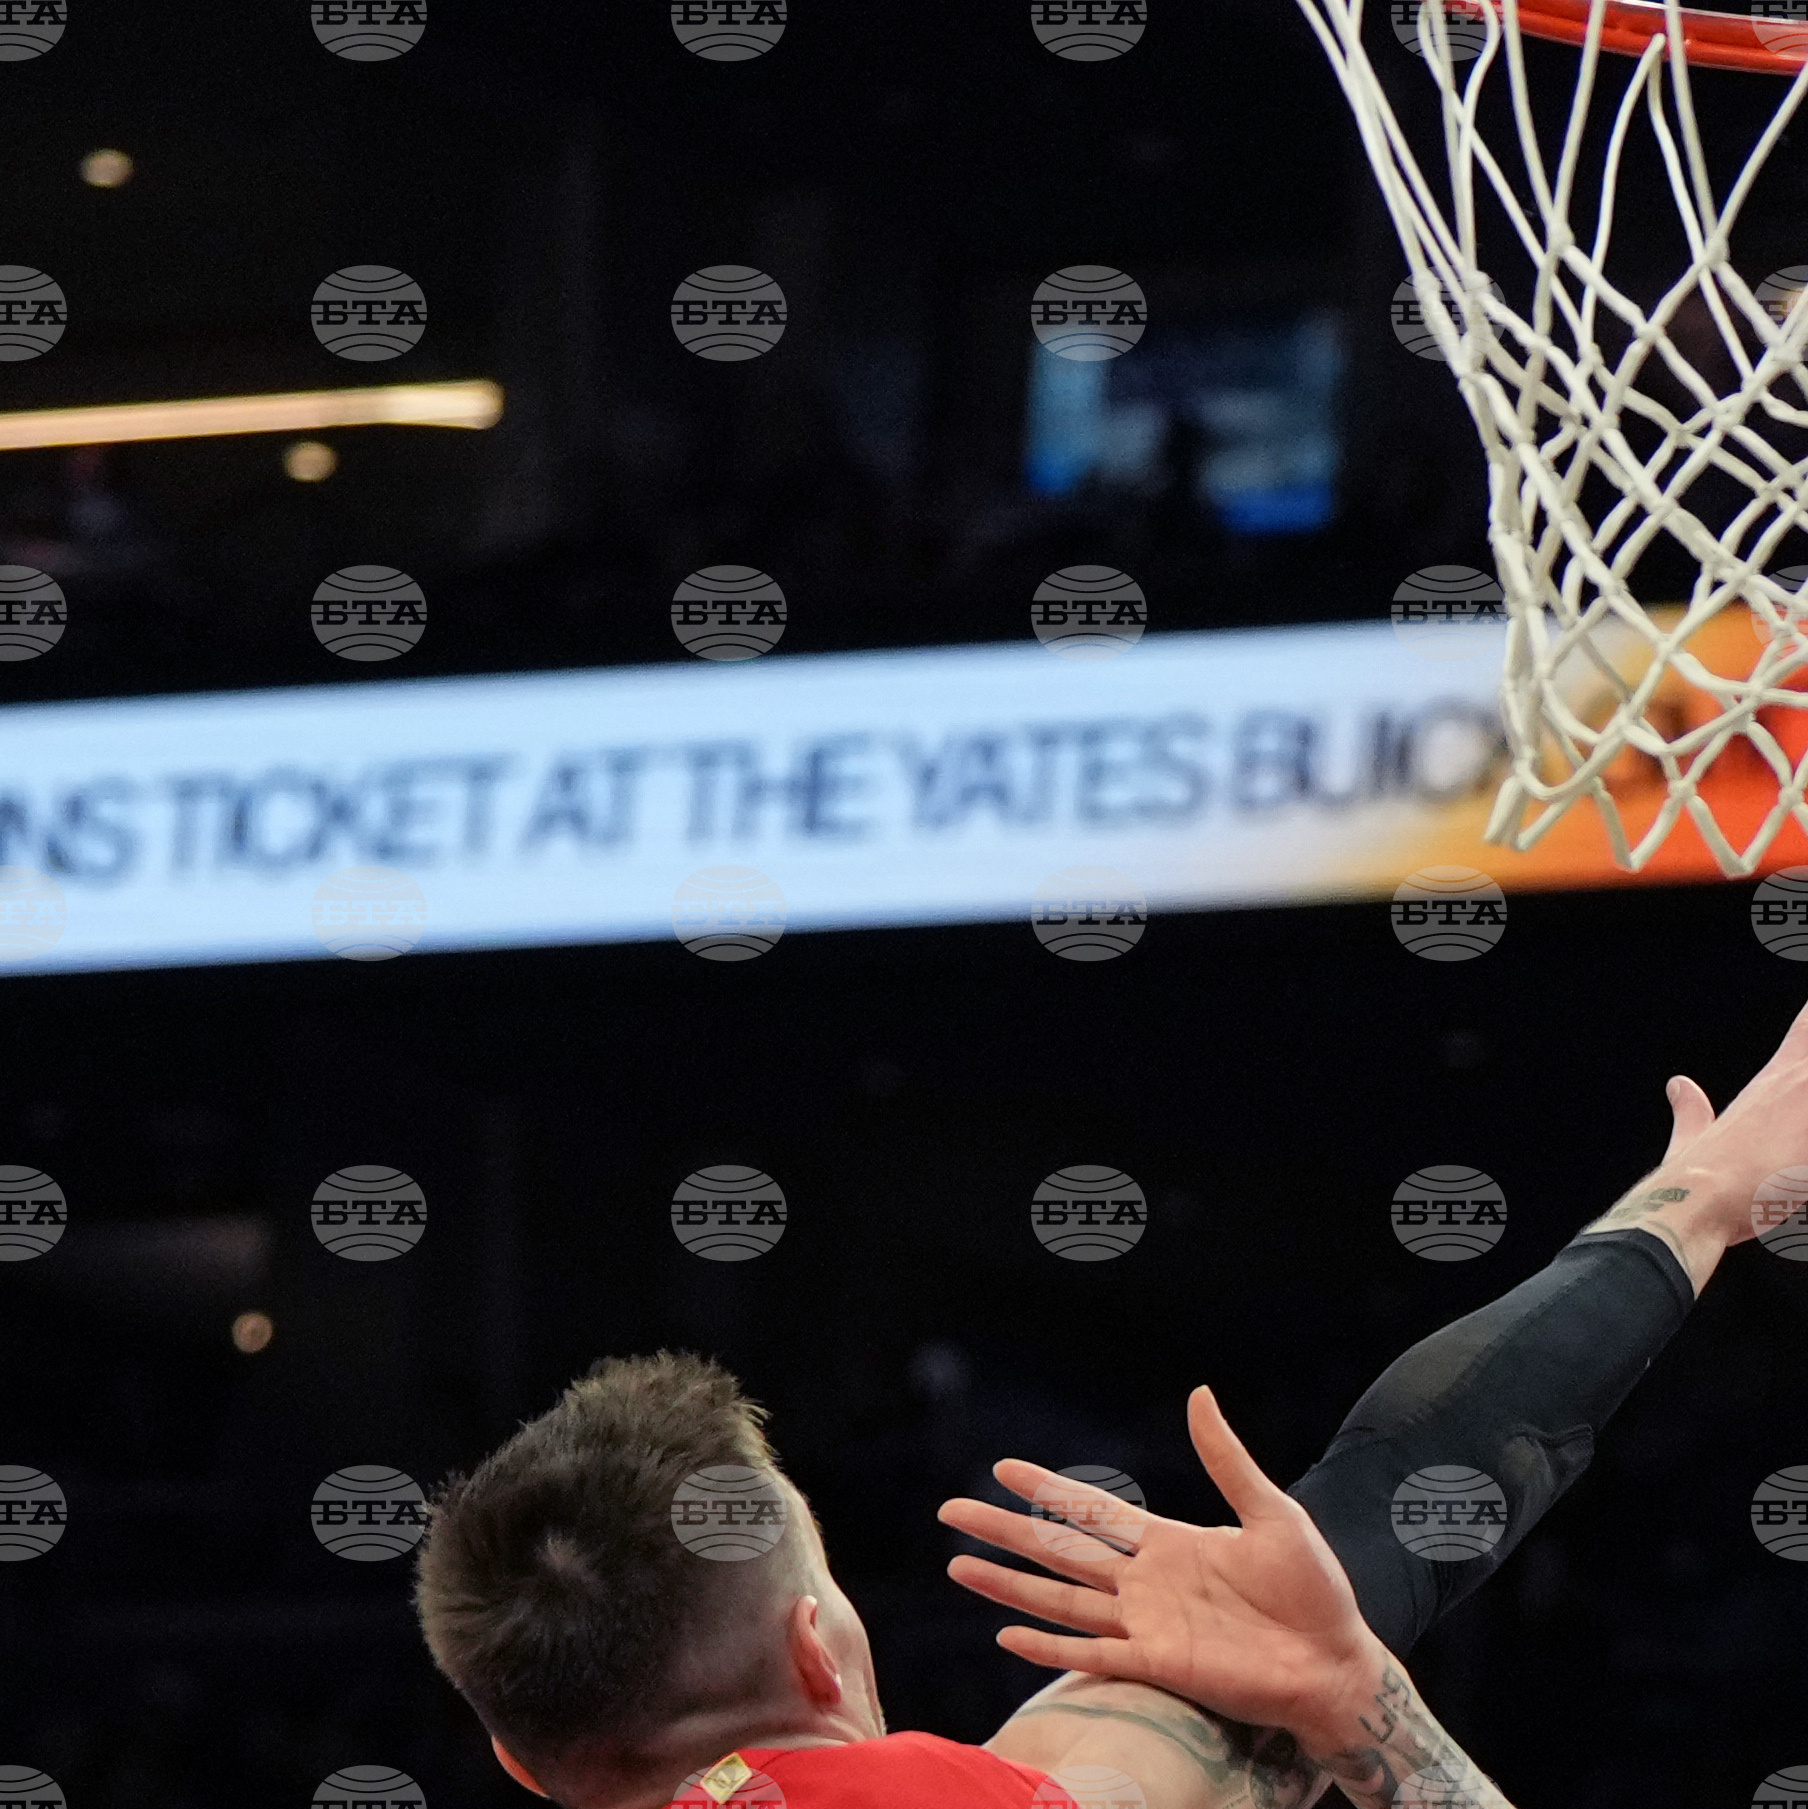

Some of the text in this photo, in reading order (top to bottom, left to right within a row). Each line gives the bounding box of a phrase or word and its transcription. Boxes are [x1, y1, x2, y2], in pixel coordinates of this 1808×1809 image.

[518, 742, 650, 856] AT
[668, 731, 884, 848] THE
[902, 708, 1213, 832] YATES
[1228, 694, 1506, 806] BUIC
